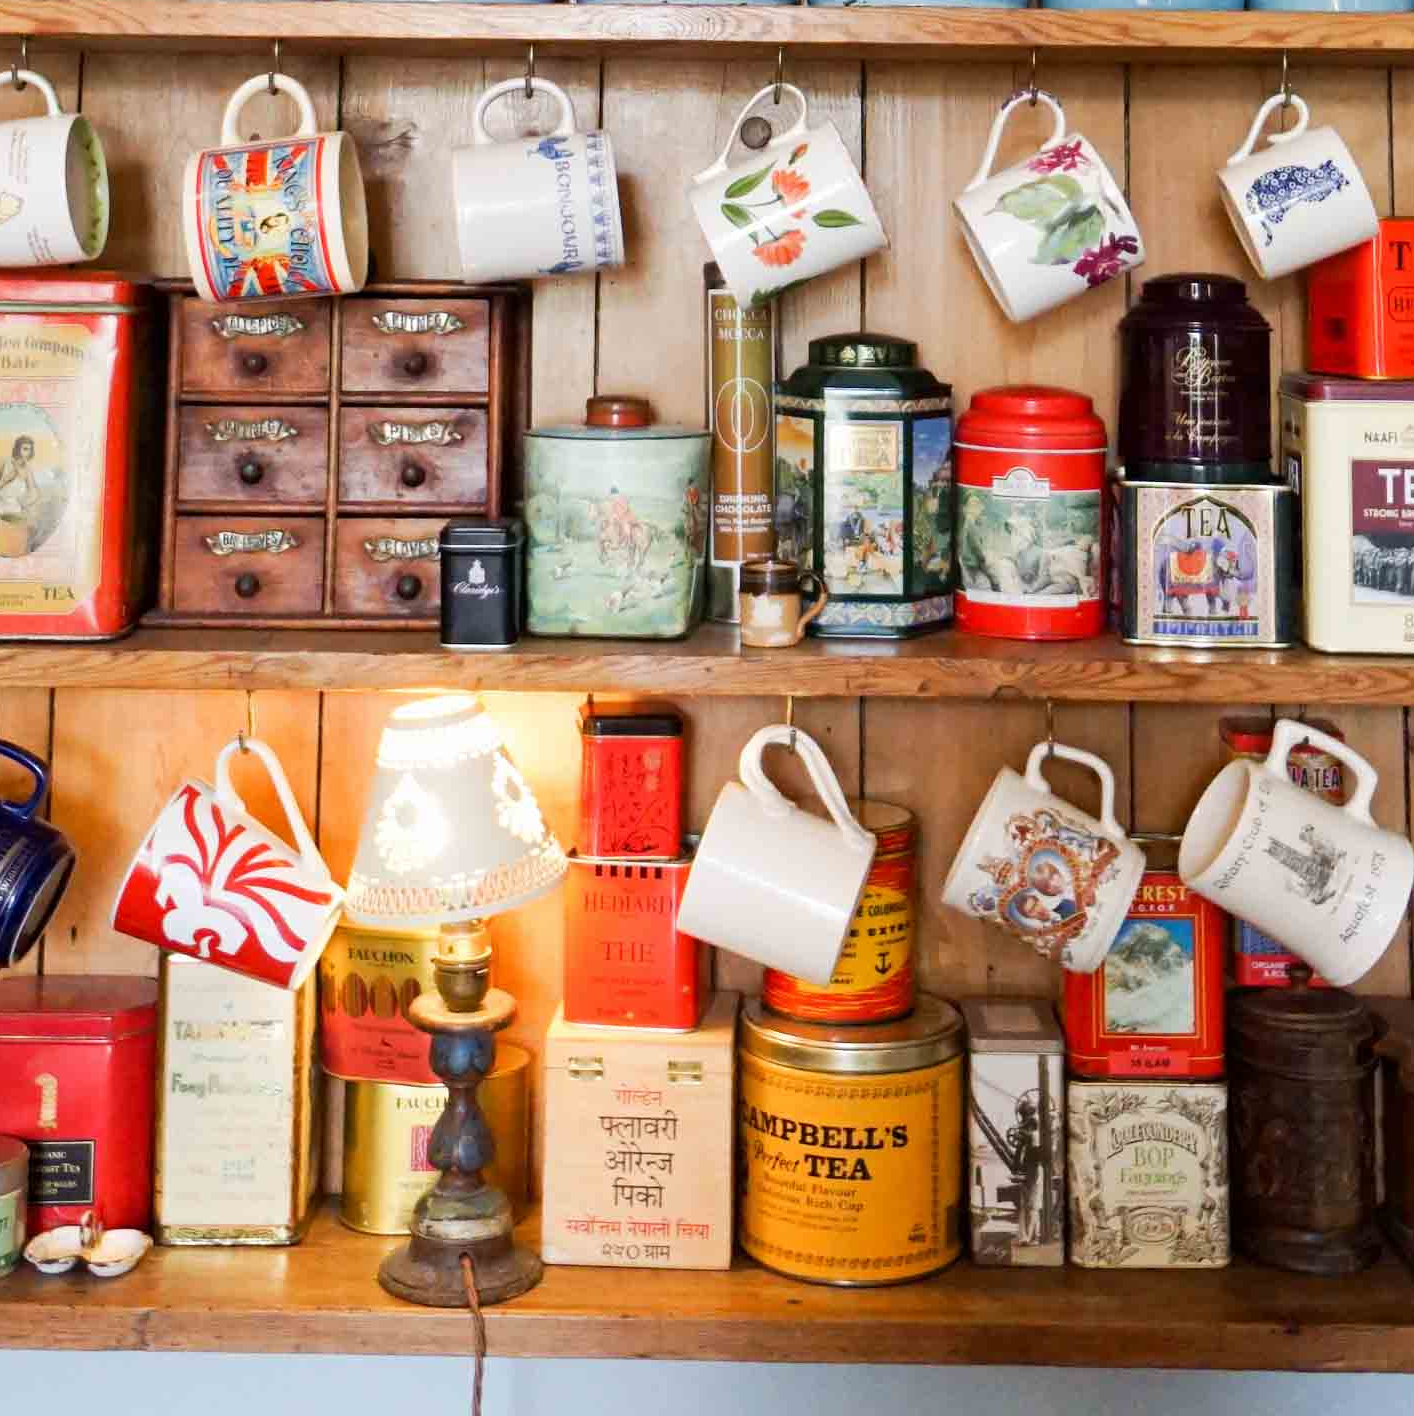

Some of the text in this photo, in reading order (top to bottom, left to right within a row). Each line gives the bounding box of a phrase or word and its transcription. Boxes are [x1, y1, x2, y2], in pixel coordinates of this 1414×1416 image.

[554, 159, 583, 273] BONJOUR
[1364, 431, 1399, 444] NAAFI
[1181, 506, 1232, 540] TEA
[1363, 508, 1400, 519] STRONG
[42, 584, 76, 601] TEA
[1138, 884, 1188, 903] REST
[348, 947, 415, 965] FAUCHON
[598, 1109, 679, 1140] फ्लावरी
[803, 1153, 874, 1182] TEA
[1134, 1145, 1175, 1169] BOP
[611, 1175, 666, 1210] पिको
